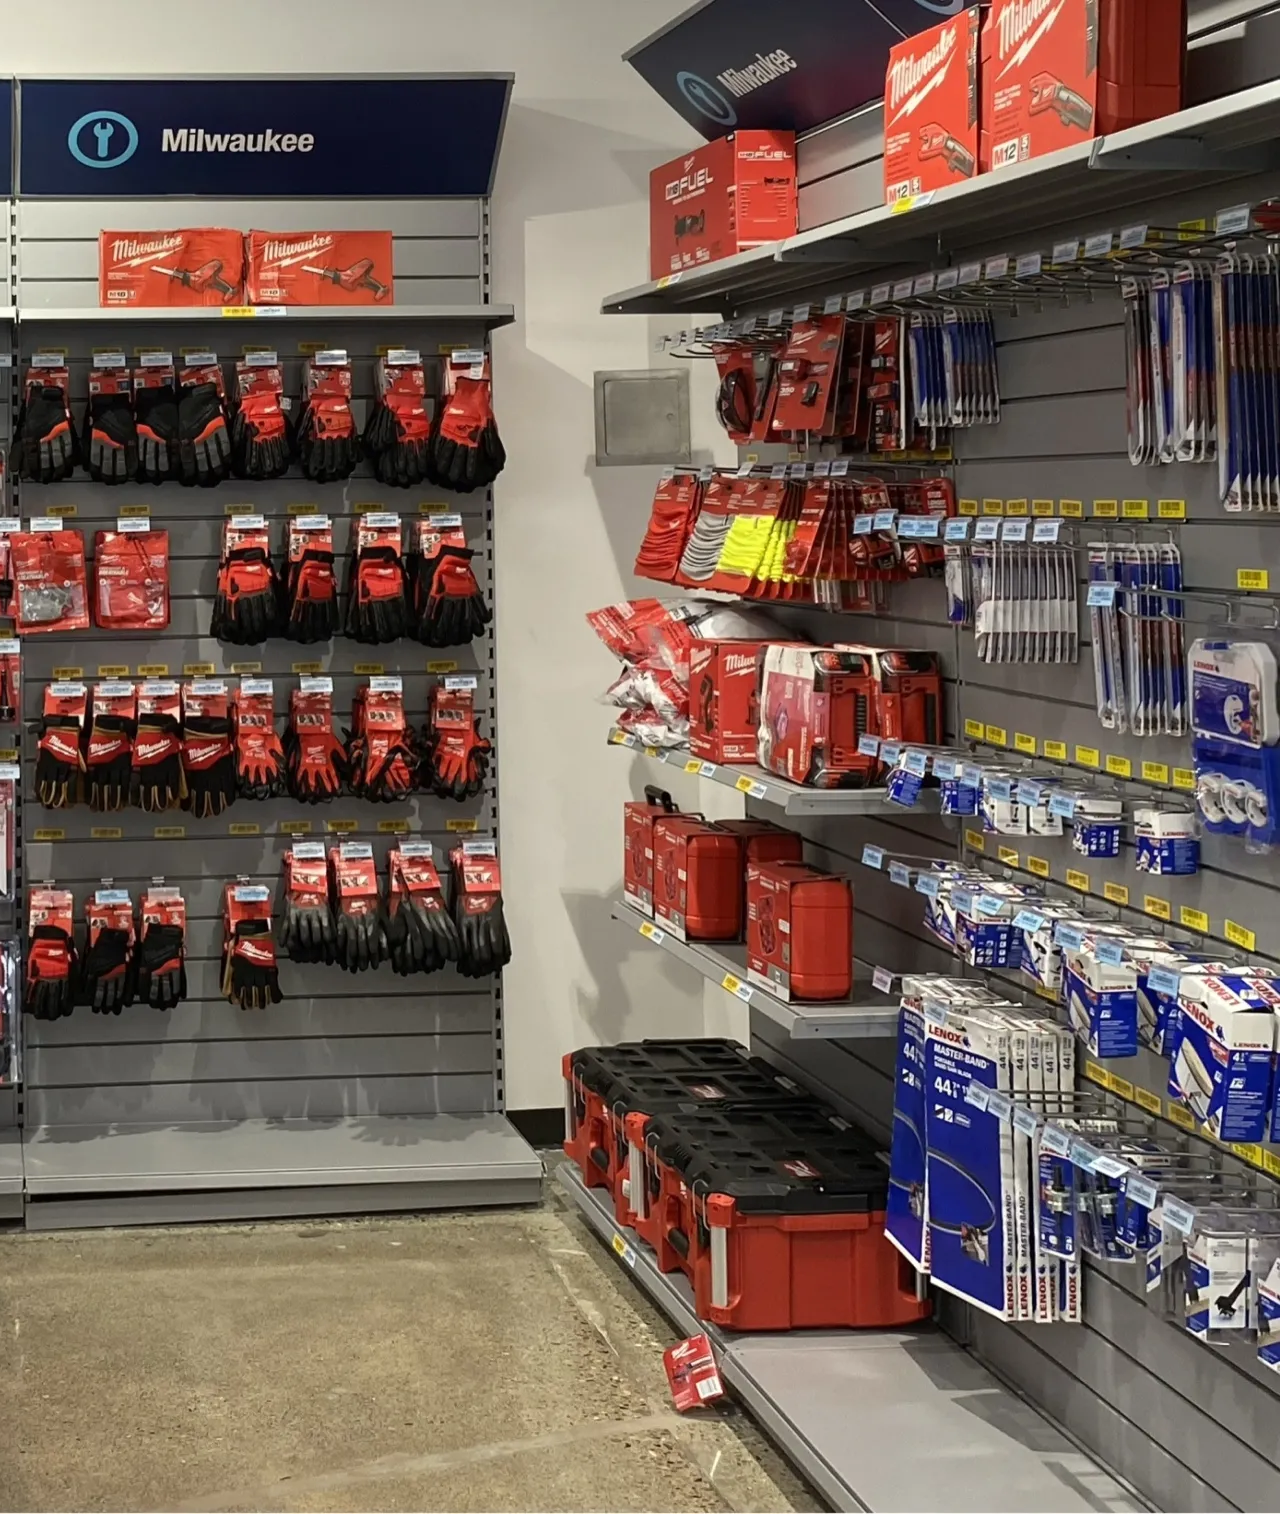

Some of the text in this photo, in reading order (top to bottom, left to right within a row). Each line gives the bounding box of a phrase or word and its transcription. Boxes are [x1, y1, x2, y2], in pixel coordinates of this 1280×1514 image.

[717, 48, 797, 98] Milwaukee
[160, 127, 315, 155] Milwaukee
[994, 143, 1017, 166] M12
[680, 167, 713, 195] FUEL
[109, 235, 183, 262] Milwaukee
[261, 235, 332, 262] Milwaukee
[1202, 977, 1240, 1006] LENOX
[1181, 1000, 1214, 1032] LENOX
[928, 1024, 961, 1044] LENOX
[933, 1043, 986, 1070] MASTER-BAND
[1006, 1193, 1014, 1257] MASTER-BAND
[1021, 1195, 1029, 1258] MASTER-BAND
[1020, 1276, 1028, 1318] LENOX
[1069, 1276, 1077, 1319] LENOX
